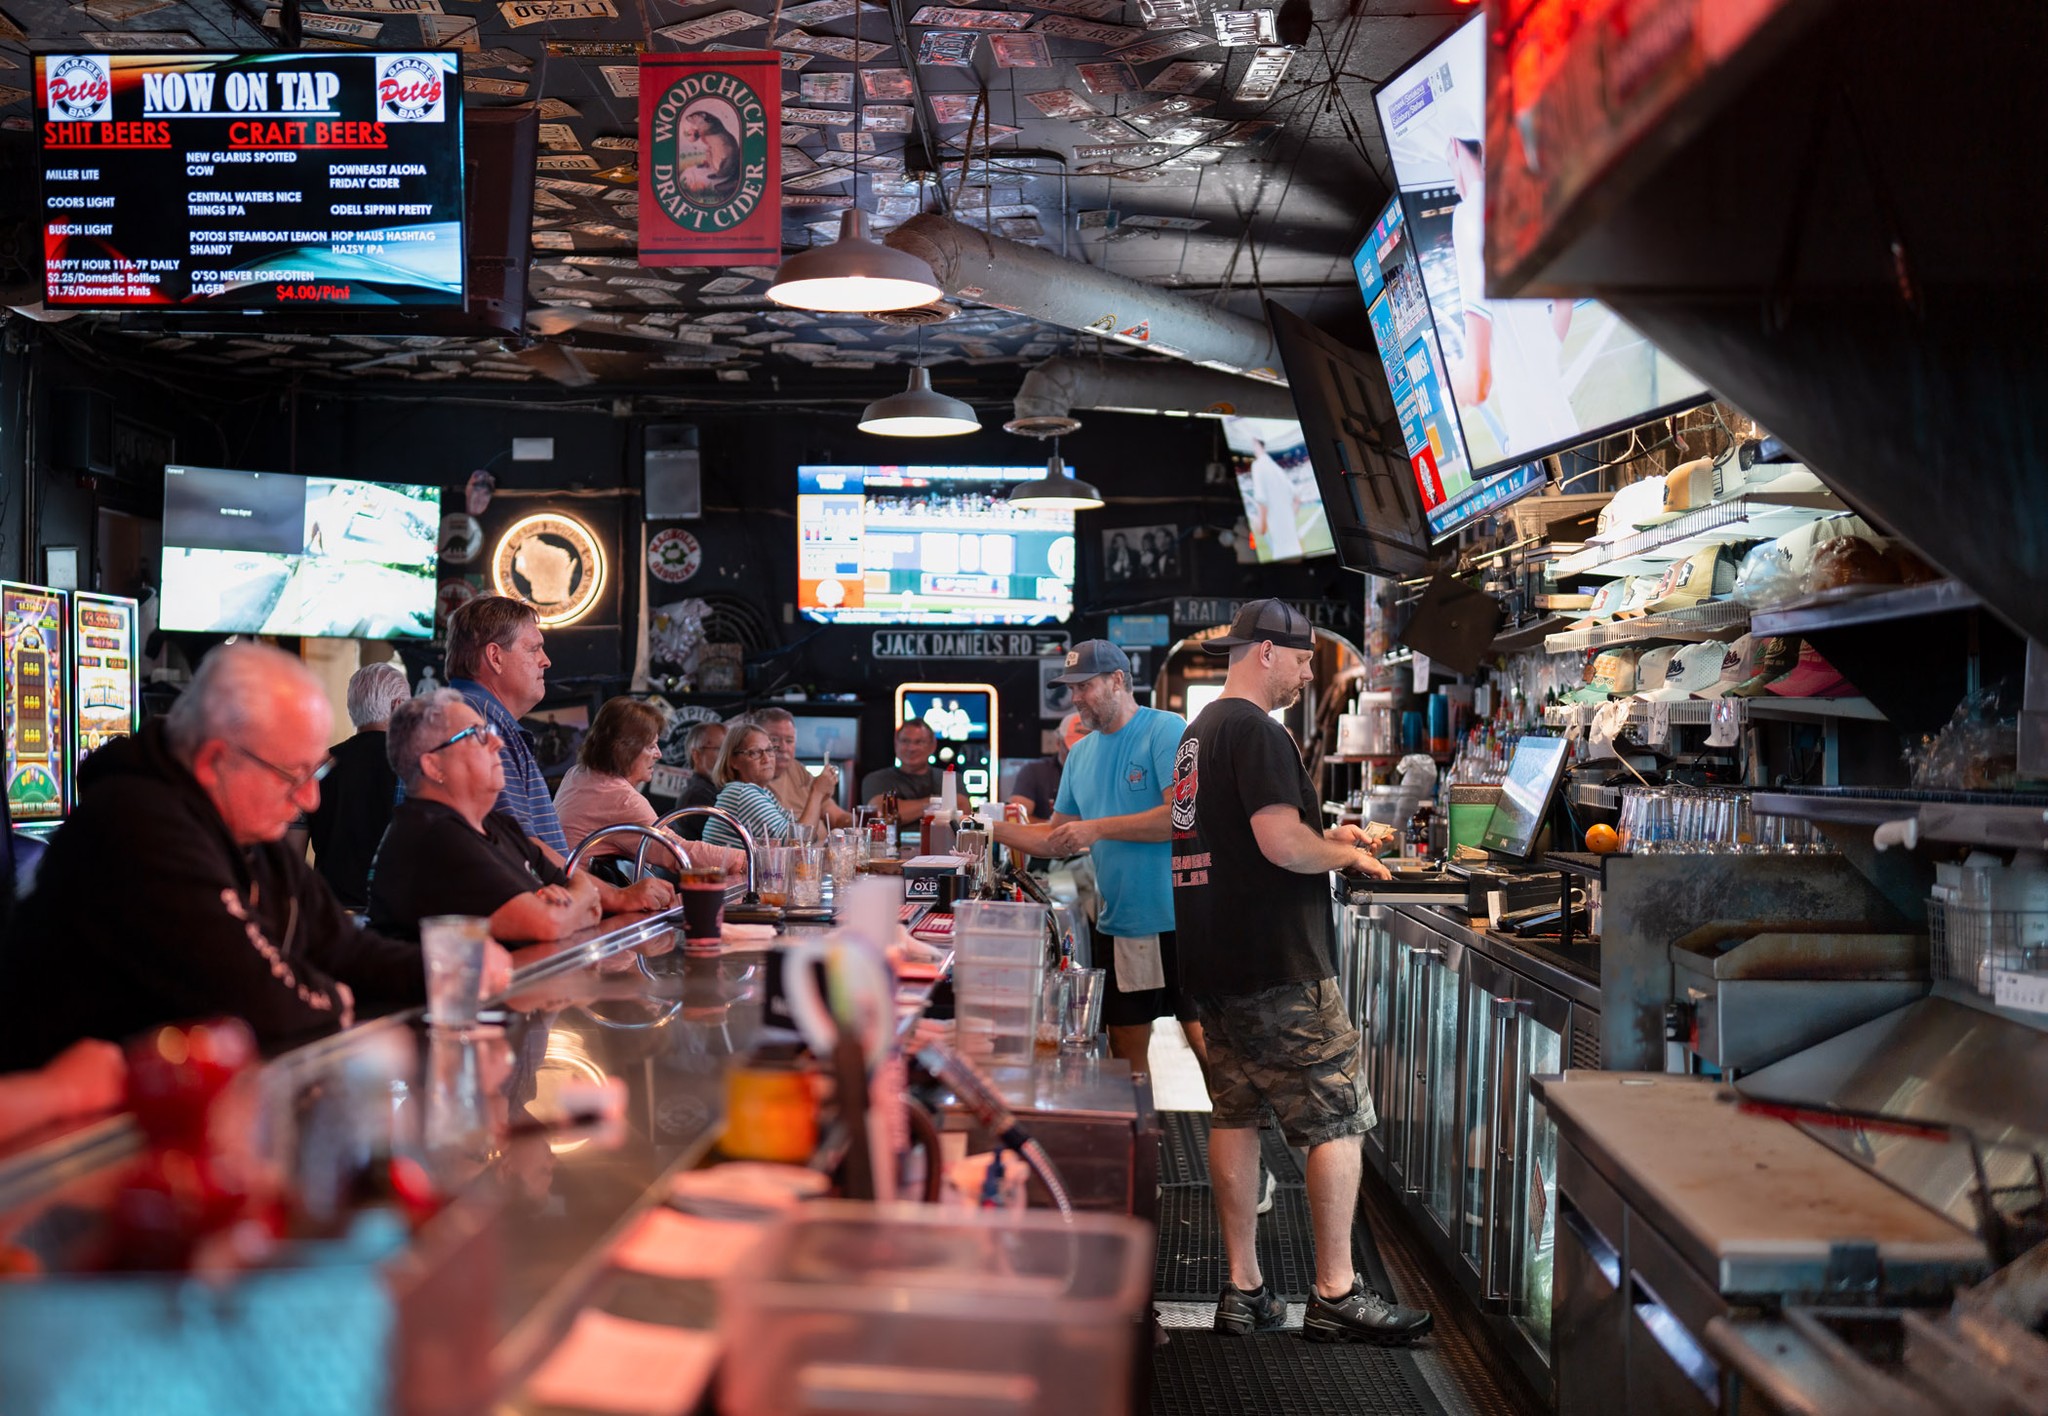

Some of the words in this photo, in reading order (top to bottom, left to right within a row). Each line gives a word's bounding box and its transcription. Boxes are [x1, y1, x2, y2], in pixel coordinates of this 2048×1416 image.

[514, 2, 608, 18] 062711
[58, 59, 99, 77] GARAGE
[388, 59, 433, 78] GARAGE
[49, 76, 108, 107] Pete's
[142, 72, 216, 112] NOW
[225, 72, 268, 111] ON
[277, 72, 340, 110] TAP
[378, 76, 441, 109] Pete's
[68, 107, 94, 118] BAR
[398, 109, 425, 119] BAR
[656, 74, 764, 143] WOODCHUCK
[44, 122, 92, 144] SHIT
[101, 122, 171, 144] BEERS
[229, 122, 308, 144] CRAFT
[316, 122, 387, 144] BEERS
[186, 152, 210, 162] NEW
[212, 152, 252, 162] GLARUS
[254, 152, 297, 162] SPOTTED
[46, 170, 79, 180] MILLER
[82, 170, 100, 180] LITE
[186, 166, 214, 176] COW
[329, 164, 387, 176] DOWNEAST
[389, 164, 426, 176] ALOHA
[330, 178, 366, 188] FRIDAY
[368, 178, 400, 188] CIDER
[188, 192, 233, 202] CENTRAL
[235, 192, 274, 202] WATERS
[276, 192, 302, 202] NICE
[655, 164, 708, 228] DRAFT
[47, 197, 84, 208] COORS
[86, 197, 115, 208] LIGHT
[188, 205, 226, 216] THINGS
[228, 205, 246, 216] IPA
[330, 204, 362, 215] ODELL
[364, 204, 396, 215] SIPPIN
[398, 204, 432, 215] PRETTY
[48, 224, 82, 235] BUSCH
[84, 224, 113, 235] LIGHT
[190, 232, 226, 242] POTOSI
[228, 232, 288, 242] STEAMBOAT
[290, 232, 328, 242] LEMON
[332, 231, 354, 242] HOP
[356, 231, 384, 242] HAUS
[386, 231, 436, 242] HASHTAG
[190, 244, 232, 255] SHANDY
[367, 244, 384, 254] IPA
[46, 260, 80, 270] HAPPY
[82, 260, 110, 270] HOUR
[113, 260, 148, 270] 11A-7P
[150, 260, 180, 270] DAILY
[48, 272, 124, 283] $2.25/Domestic
[126, 272, 160, 283] Bottles
[191, 270, 218, 281] O'SO
[220, 270, 252, 281] NEVER
[255, 270, 314, 281] FORGOTTEN
[48, 286, 124, 296] $1.75/Domestic
[127, 286, 150, 296] Pints
[192, 284, 226, 294] LAGER
[276, 285, 350, 300] $4.00/Pint
[1188, 600, 1218, 622] RAT
[882, 634, 928, 655] JACK
[932, 633, 1004, 656] DANIEL'S
[1009, 634, 1032, 655] RD
